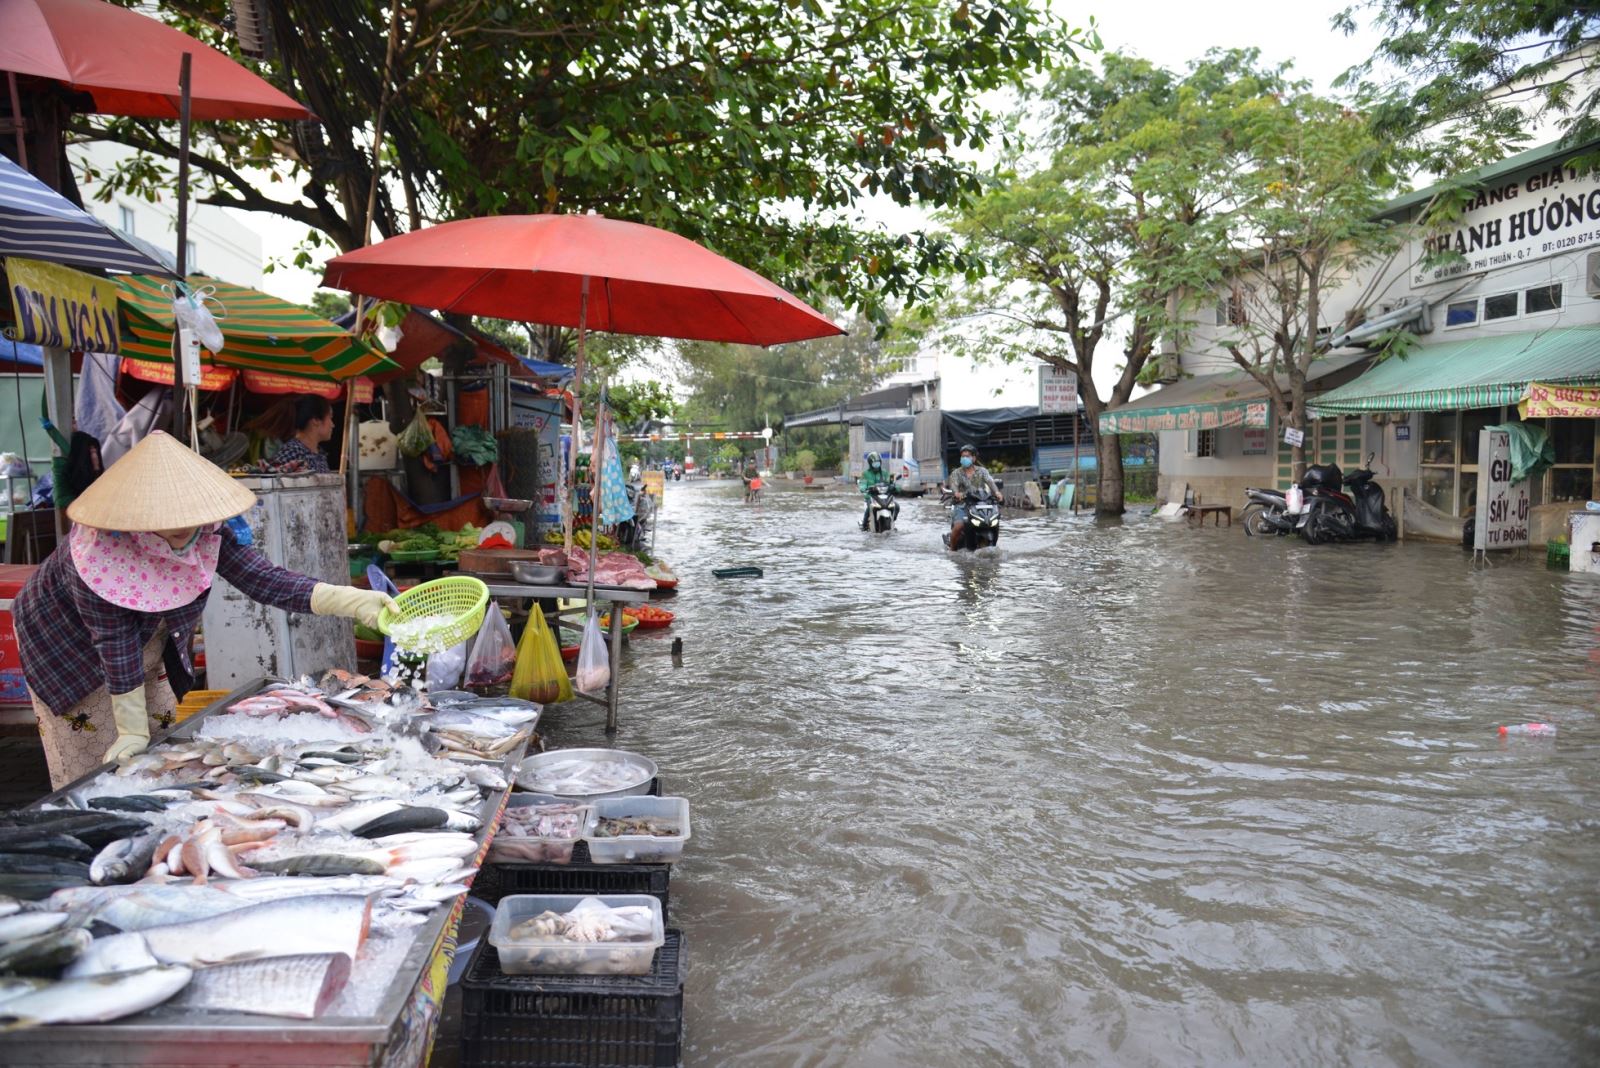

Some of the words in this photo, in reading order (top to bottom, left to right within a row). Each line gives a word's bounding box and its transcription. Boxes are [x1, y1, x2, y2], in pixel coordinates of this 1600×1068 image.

[1556, 236, 1576, 249] 0120
[1578, 231, 1593, 244] 874
[1526, 247, 1531, 257] 7
[1489, 491, 1510, 523] SẤY
[1487, 528, 1501, 543] TỰ
[1503, 525, 1528, 542] ĐỘNG
